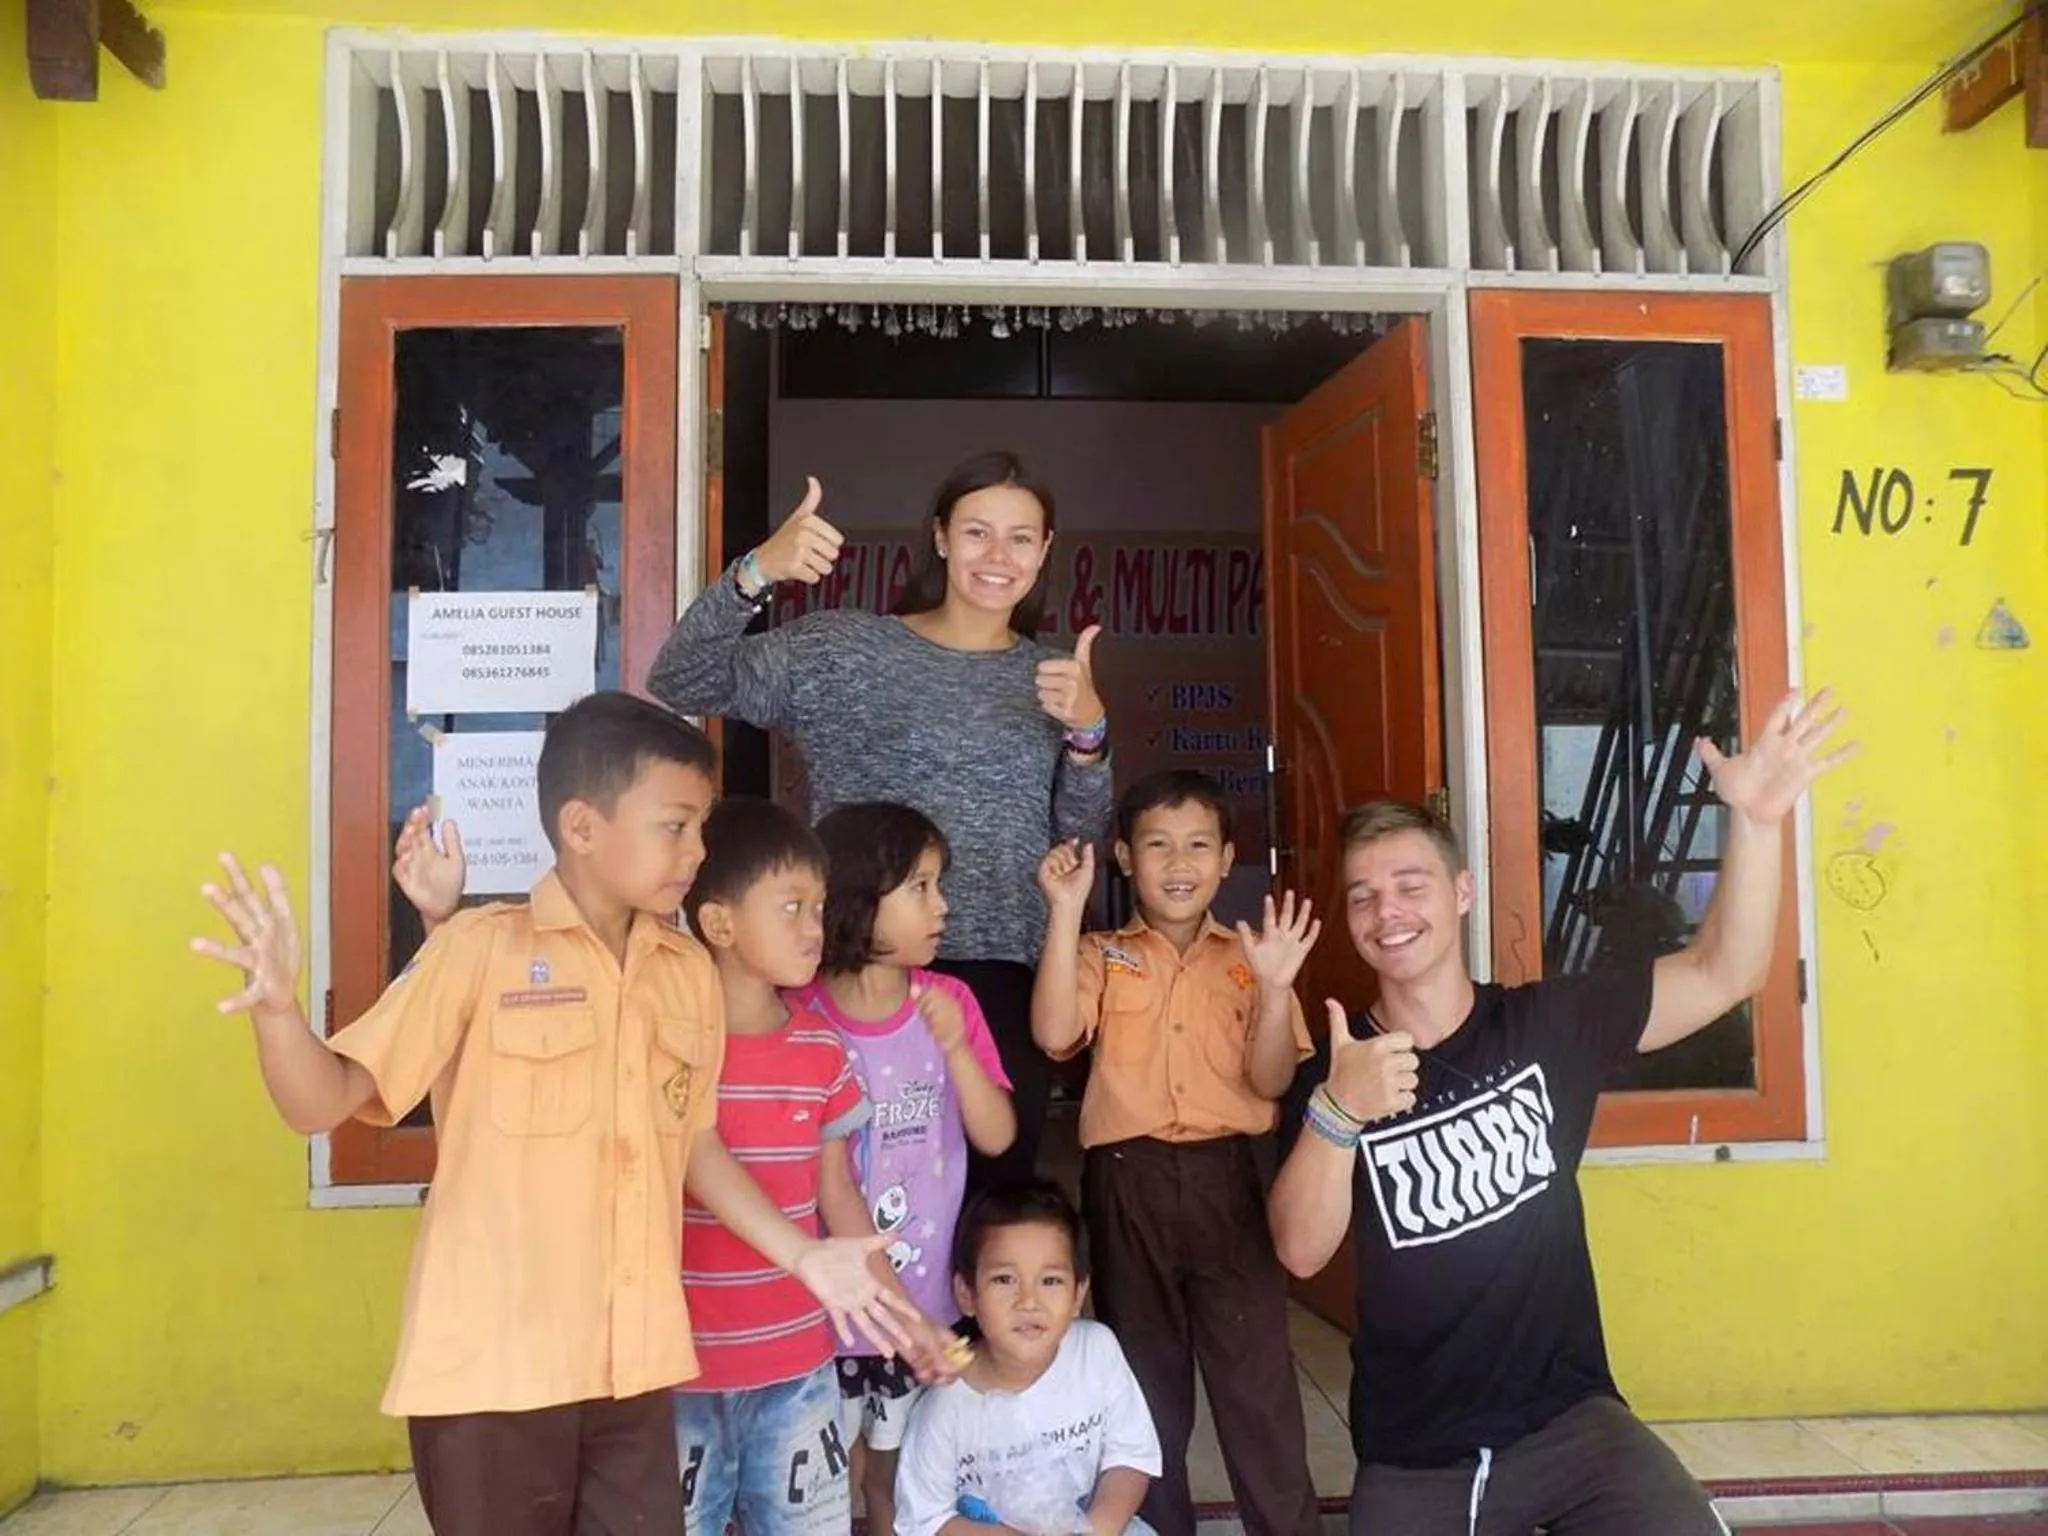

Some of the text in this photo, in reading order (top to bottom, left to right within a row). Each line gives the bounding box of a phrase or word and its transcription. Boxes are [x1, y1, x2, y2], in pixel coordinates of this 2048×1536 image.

[1113, 548, 1216, 634] MULTI
[432, 605, 582, 620] AMELIA GUEST HOUSE
[1172, 684, 1232, 708] BPJS
[1172, 726, 1237, 751] Kartu
[458, 755, 535, 768] MENERIMA
[458, 776, 497, 789] ANAK
[467, 797, 524, 809] WANITA
[1375, 1088, 1553, 1233] TURBO
